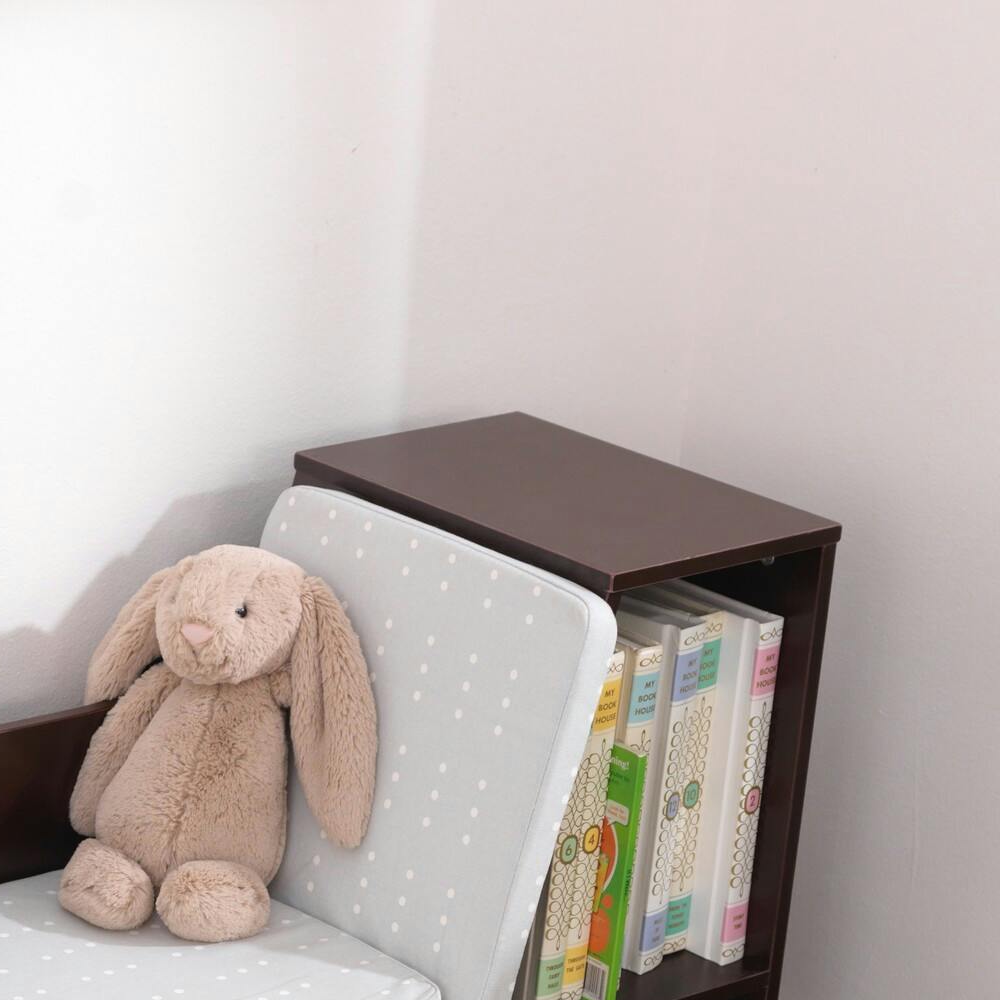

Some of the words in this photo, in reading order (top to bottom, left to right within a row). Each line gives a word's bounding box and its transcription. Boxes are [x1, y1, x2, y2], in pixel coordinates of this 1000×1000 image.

[645, 680, 655, 688] MY
[604, 688, 615, 697] MY
[598, 702, 616, 711] BOOK
[595, 712, 617, 724] HOUSE
[750, 795, 756, 807] 2
[588, 833, 595, 845] 4
[565, 843, 572, 856] 6
